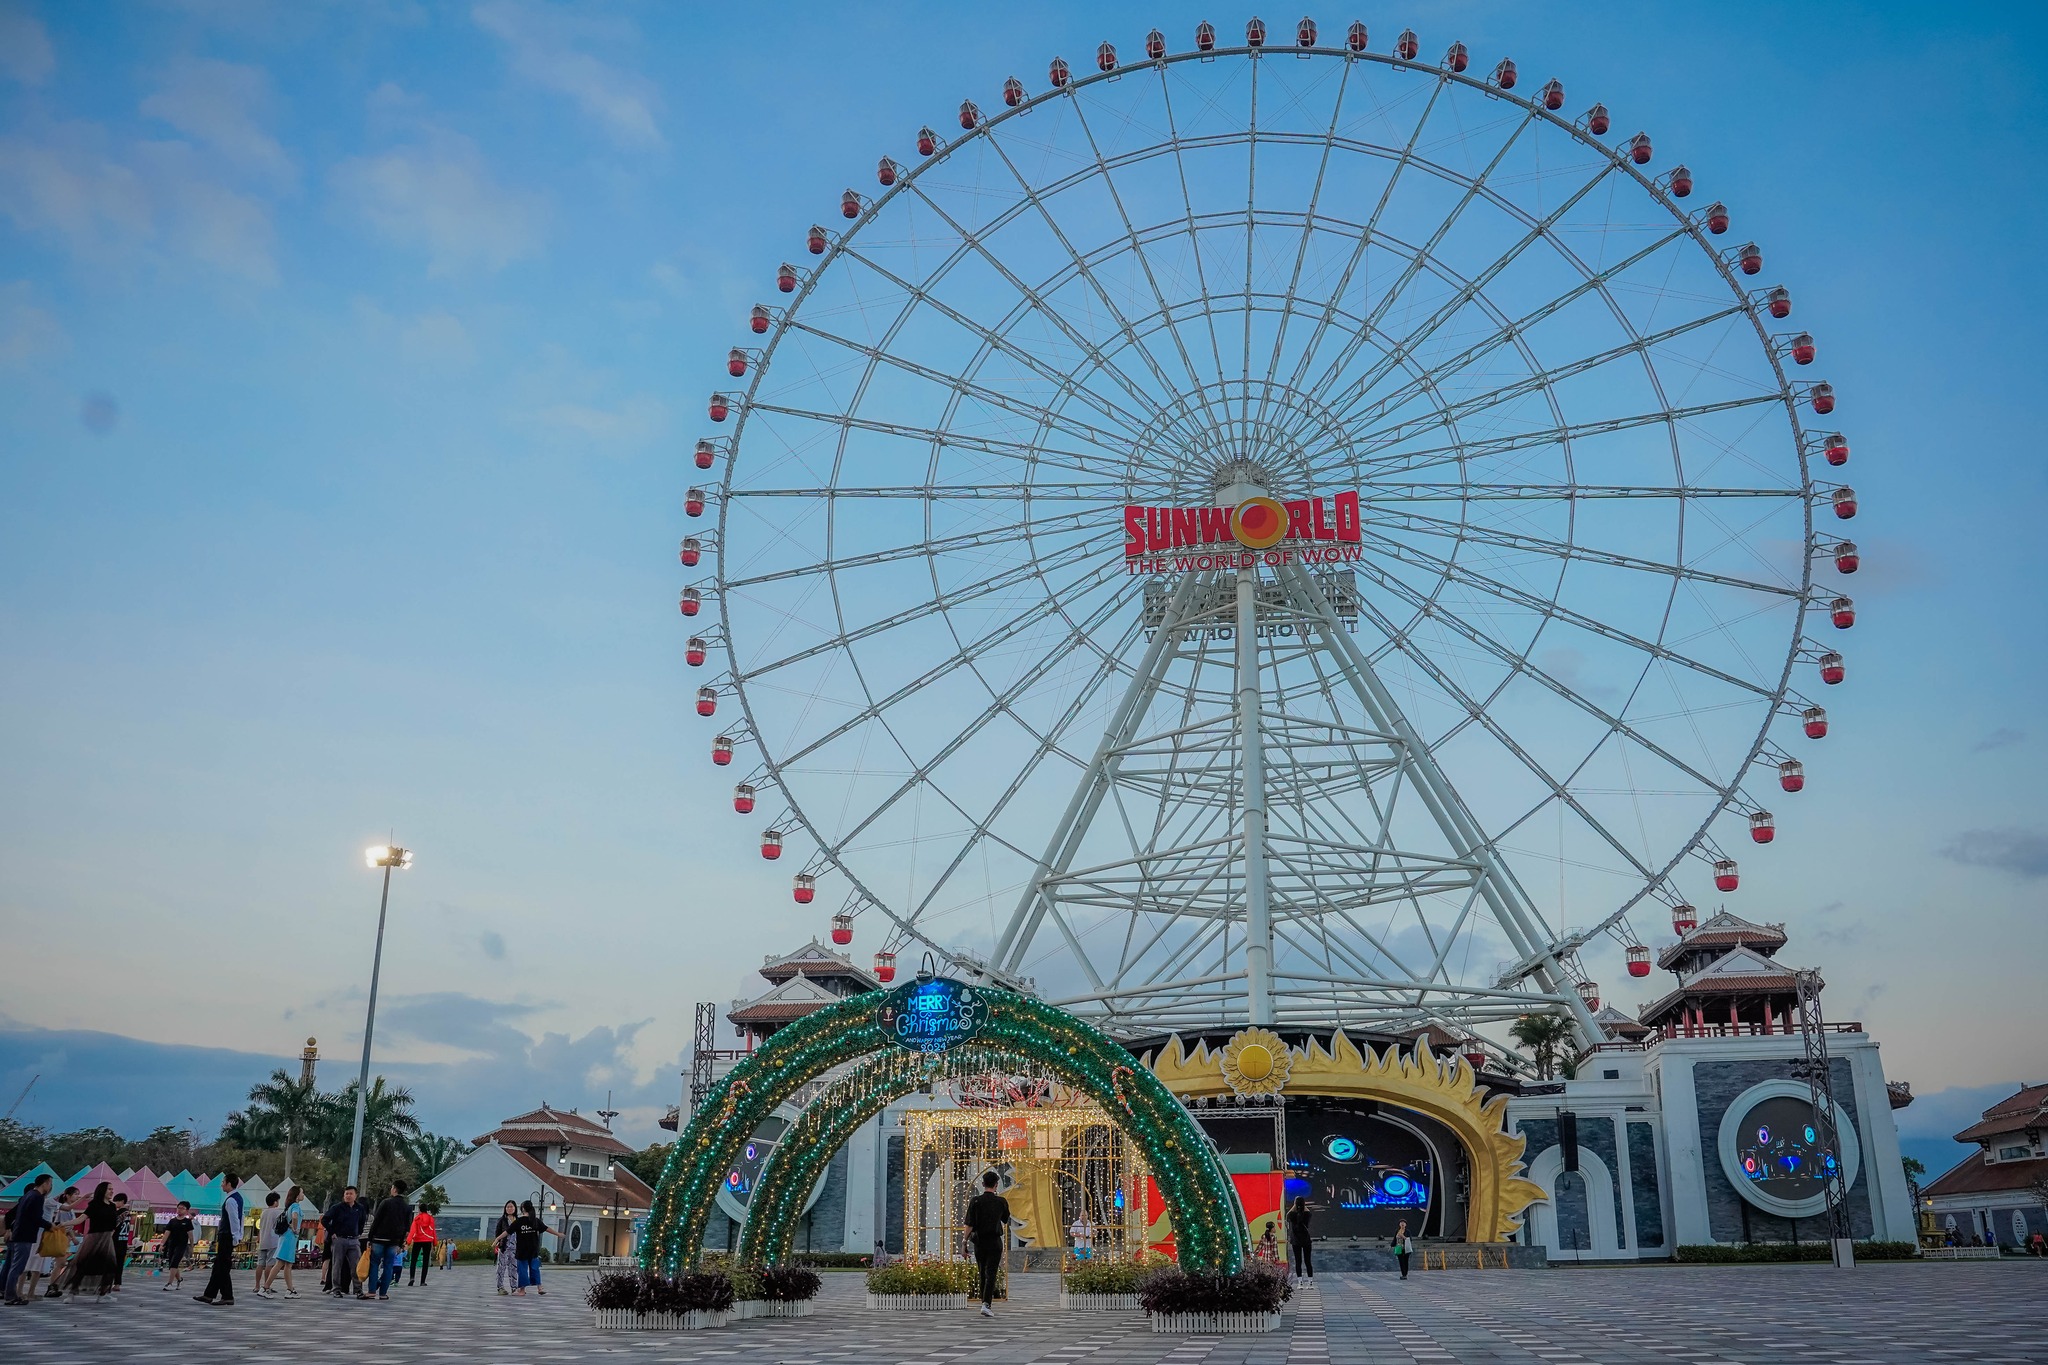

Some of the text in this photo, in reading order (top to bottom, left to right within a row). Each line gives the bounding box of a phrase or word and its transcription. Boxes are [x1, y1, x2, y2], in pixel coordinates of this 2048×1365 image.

[1126, 546, 1363, 574] THE WORLD OF WOW
[907, 995, 952, 1013] MERRY
[947, 1035, 963, 1043] YEAR
[920, 1042, 946, 1052] 2024
